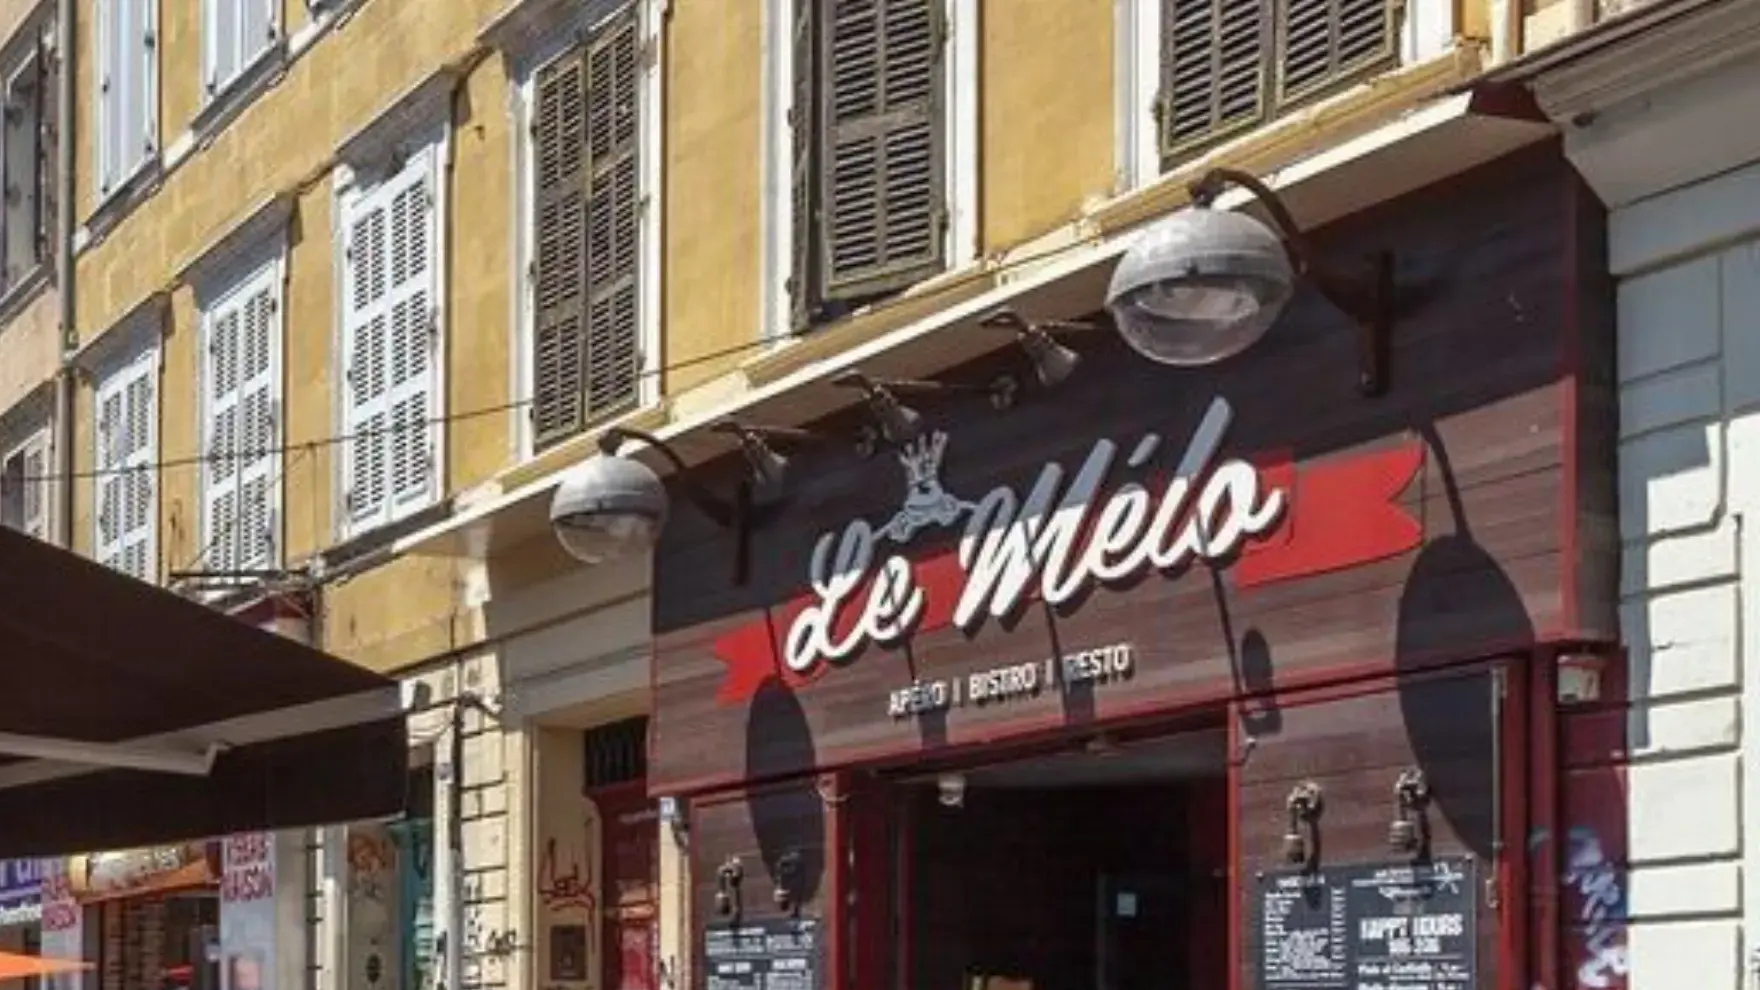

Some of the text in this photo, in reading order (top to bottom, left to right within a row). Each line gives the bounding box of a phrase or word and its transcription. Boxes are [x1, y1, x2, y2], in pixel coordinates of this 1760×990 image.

[783, 396, 1284, 670] Le Mélo
[969, 661, 1038, 701] BISTRO
[1062, 643, 1131, 684] RESTO
